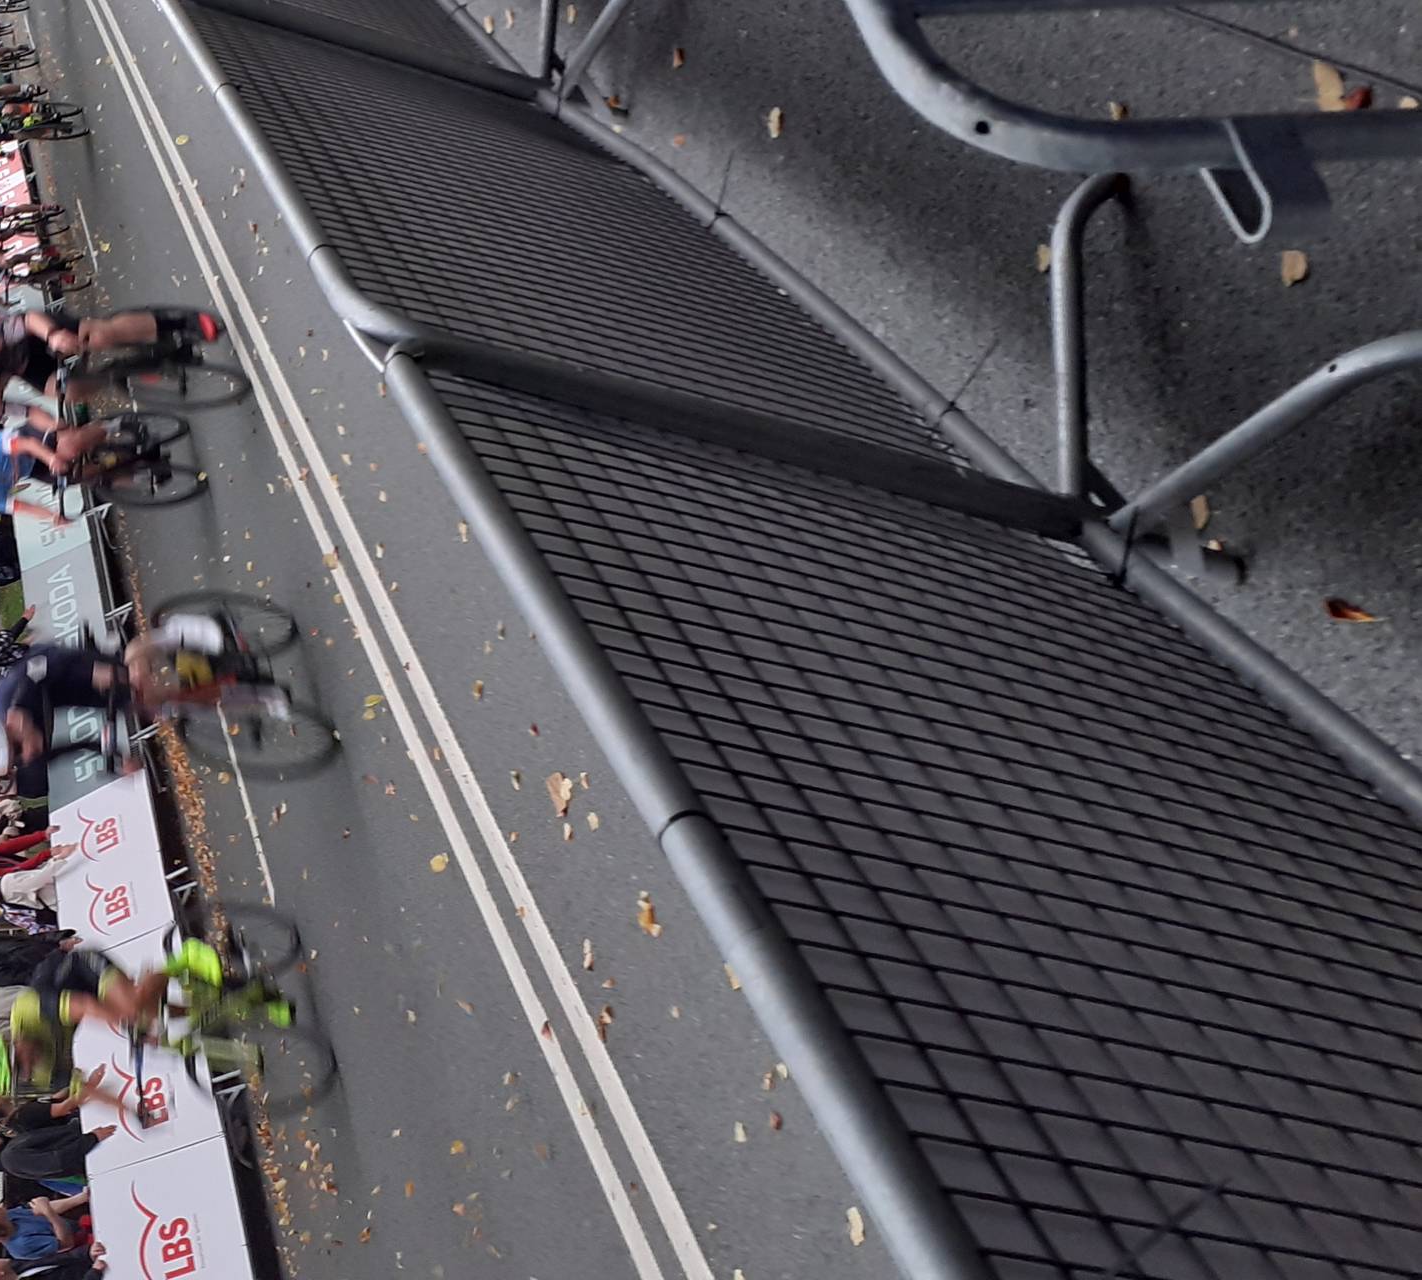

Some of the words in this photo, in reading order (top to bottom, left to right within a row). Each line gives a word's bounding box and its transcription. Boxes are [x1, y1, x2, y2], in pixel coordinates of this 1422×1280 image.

[93, 817, 119, 853] LBS
[103, 885, 131, 926] LBS
[135, 1076, 169, 1129] LBS
[158, 1217, 195, 1279] LBS
